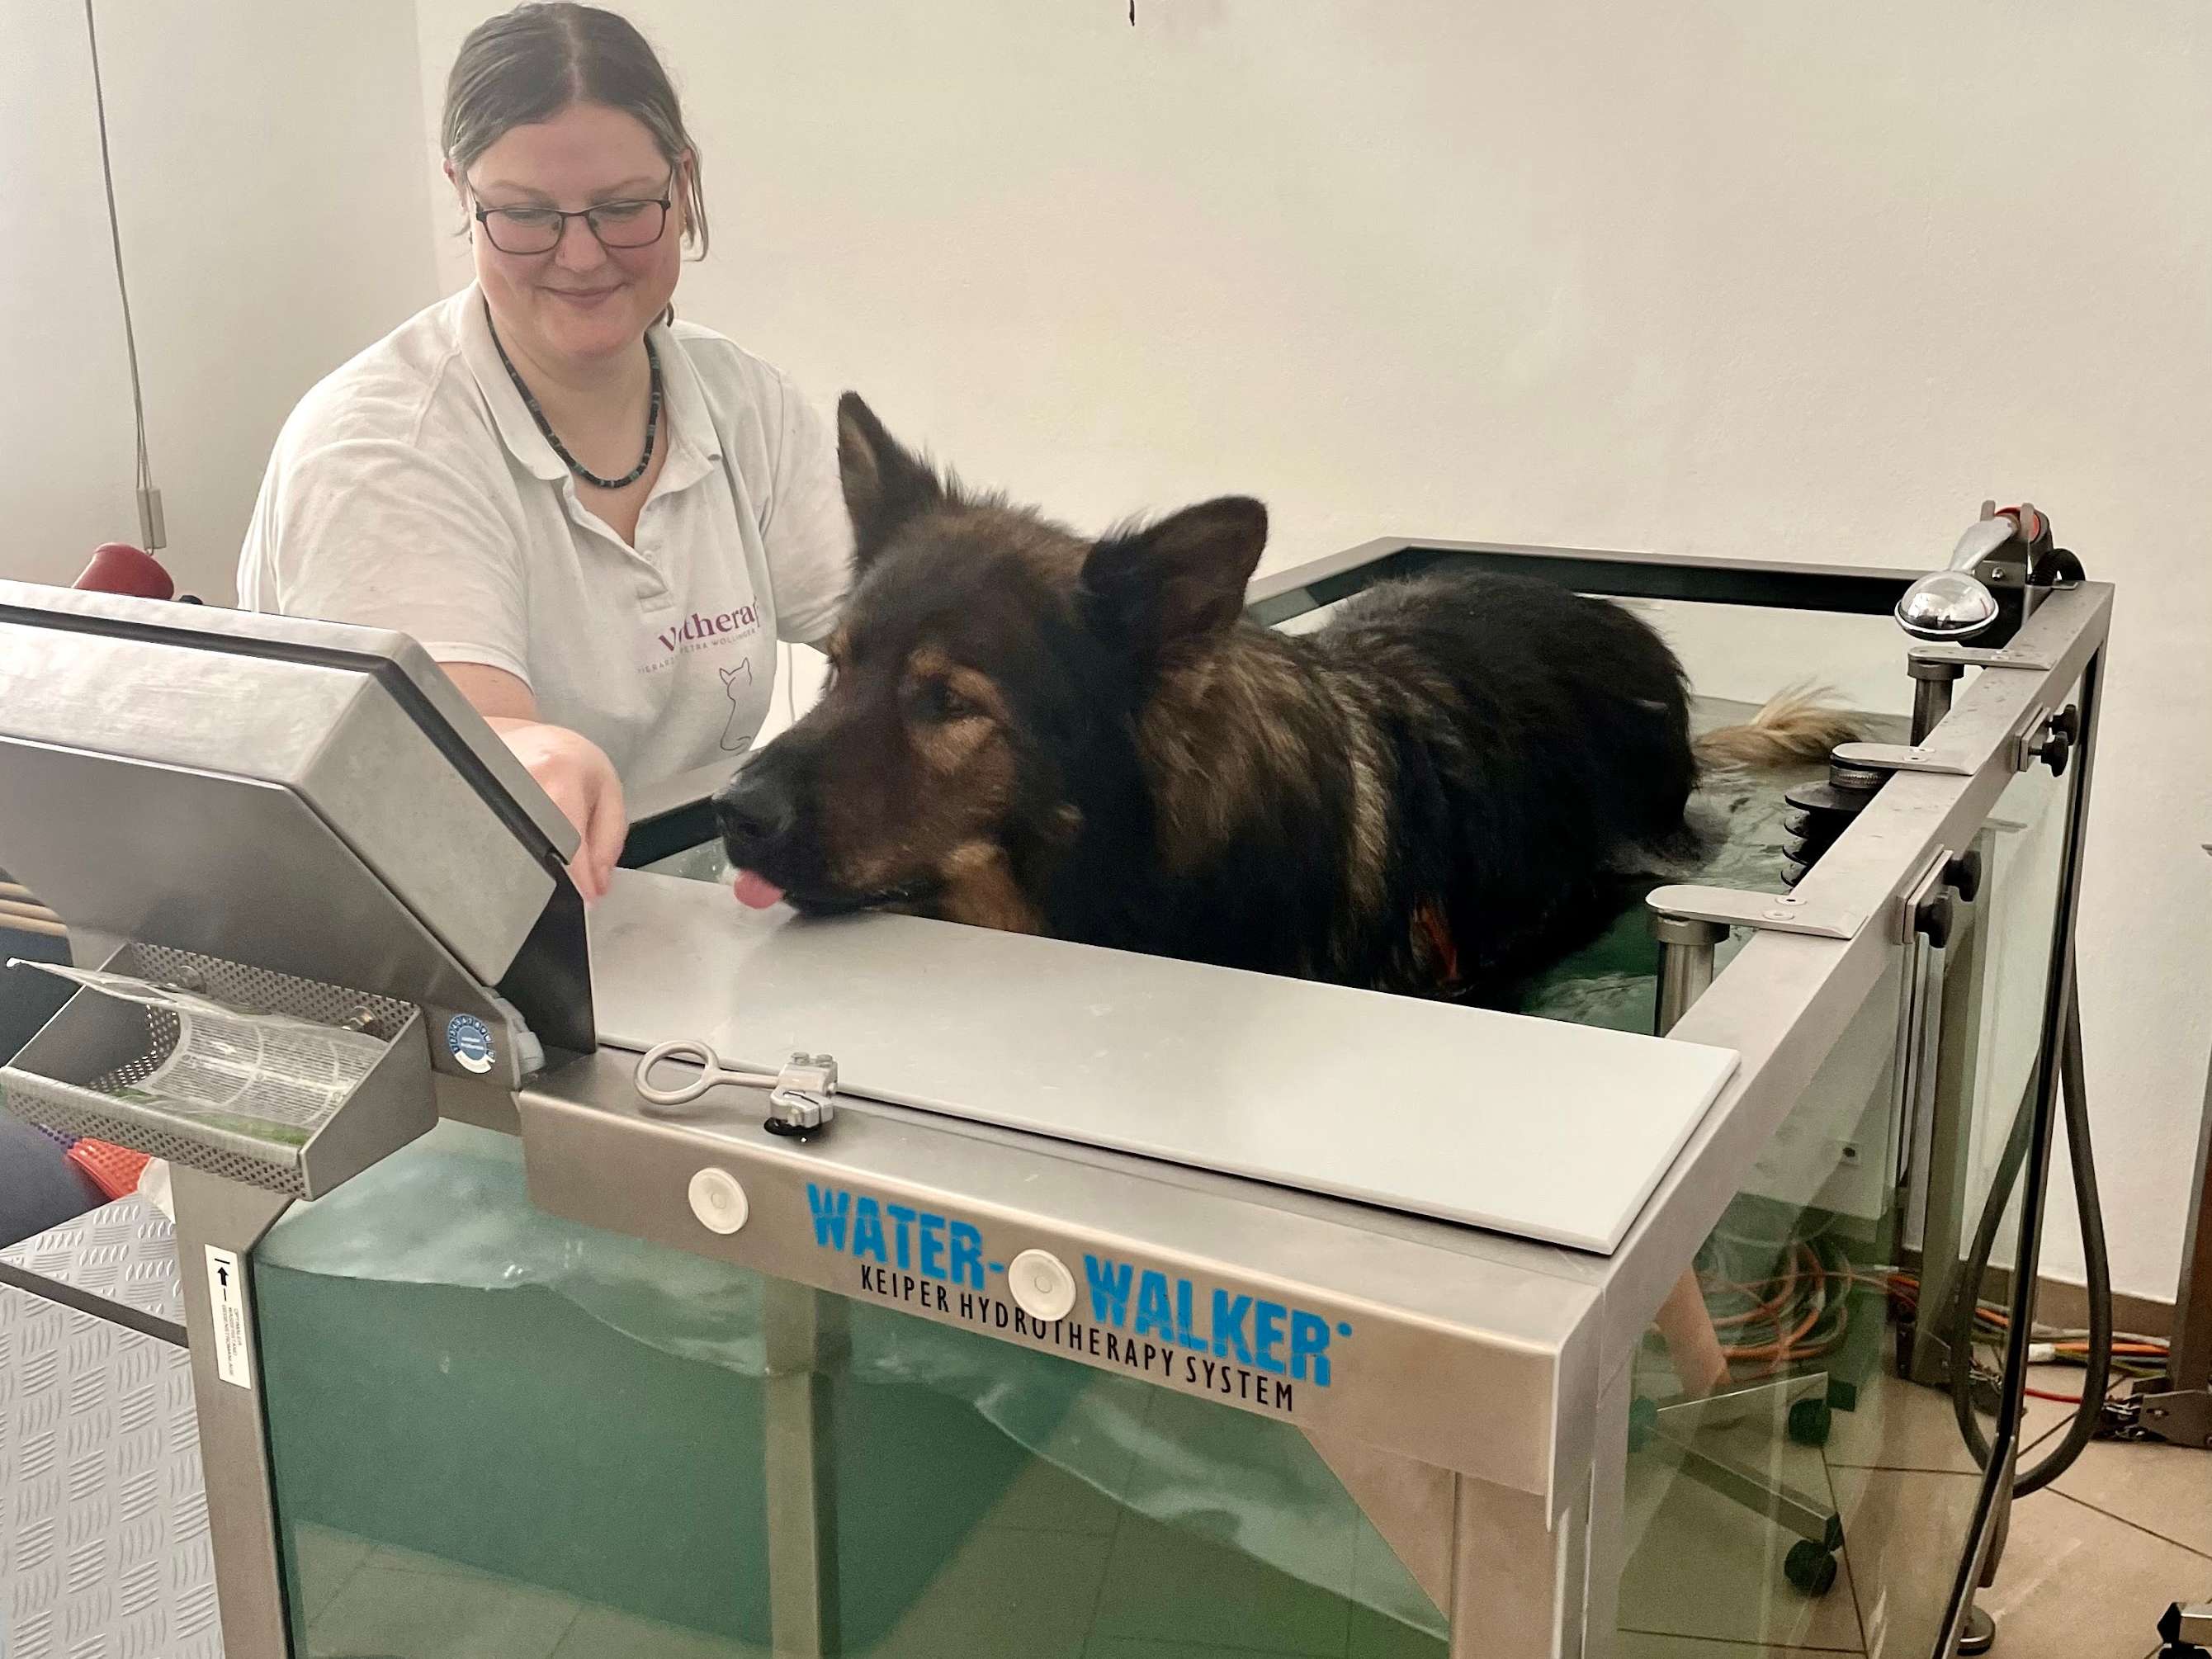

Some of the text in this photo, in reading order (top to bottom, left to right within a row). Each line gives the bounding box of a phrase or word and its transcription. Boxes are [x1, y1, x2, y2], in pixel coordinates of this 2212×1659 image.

[679, 641, 707, 655] PETRA
[806, 1181, 1331, 1387] WATER- WALKER
[861, 1264, 1293, 1412] KEIPER HYDROTHERAPY SYSTEM
